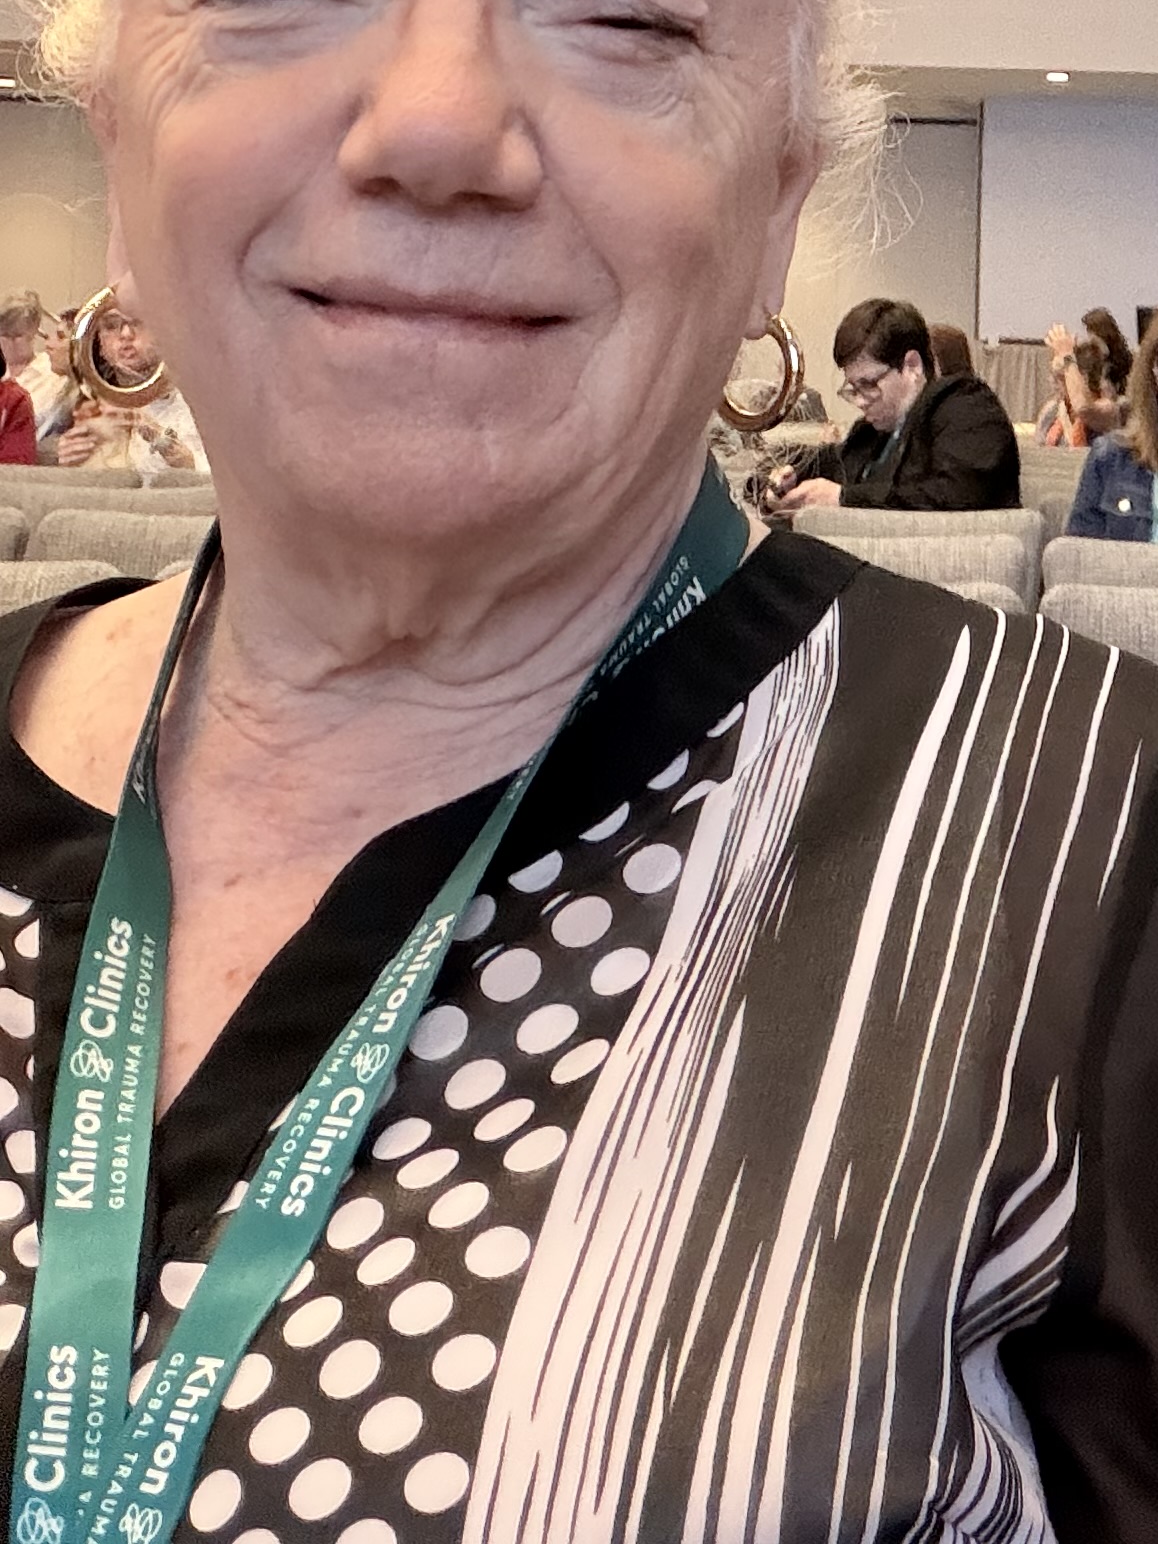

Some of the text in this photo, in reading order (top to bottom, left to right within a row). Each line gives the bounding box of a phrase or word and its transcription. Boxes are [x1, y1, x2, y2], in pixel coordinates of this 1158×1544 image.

[55, 916, 133, 1209] Khiron Clinics
[108, 933, 157, 1210] GLOBAL TRAUMA RECOVERY
[280, 913, 456, 1218] Khiron Clinics
[316, 1004, 377, 1088] TRAUMA
[254, 1098, 321, 1209] RECOVERY
[24, 1345, 78, 1493] Clinics
[80, 1348, 111, 1477] RECOVERY
[131, 1352, 186, 1440] GLOBAL
[138, 1355, 225, 1496] Khiron
